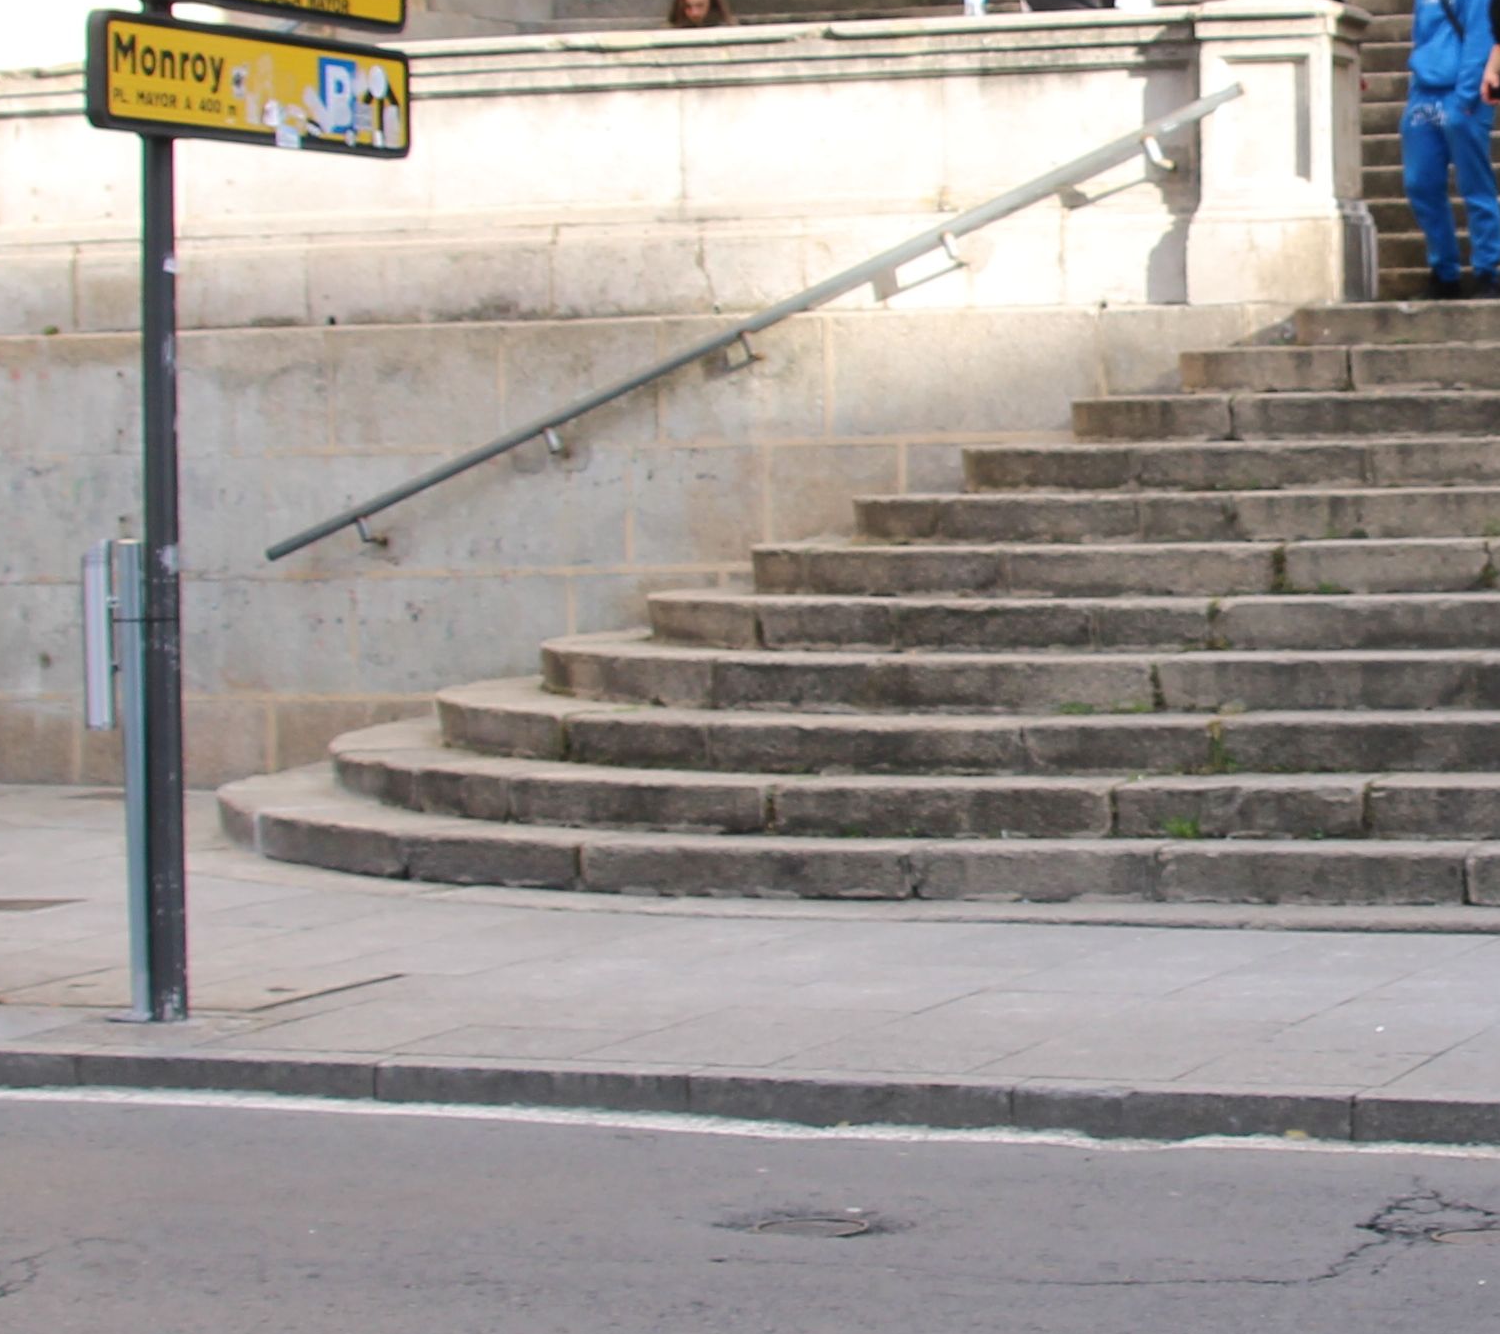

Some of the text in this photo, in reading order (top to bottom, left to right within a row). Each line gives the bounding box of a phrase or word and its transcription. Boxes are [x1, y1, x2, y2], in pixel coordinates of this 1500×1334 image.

[112, 32, 225, 94] Monroy
[136, 89, 178, 110] MAYOR
[184, 93, 192, 110] A
[199, 94, 222, 115] 400
